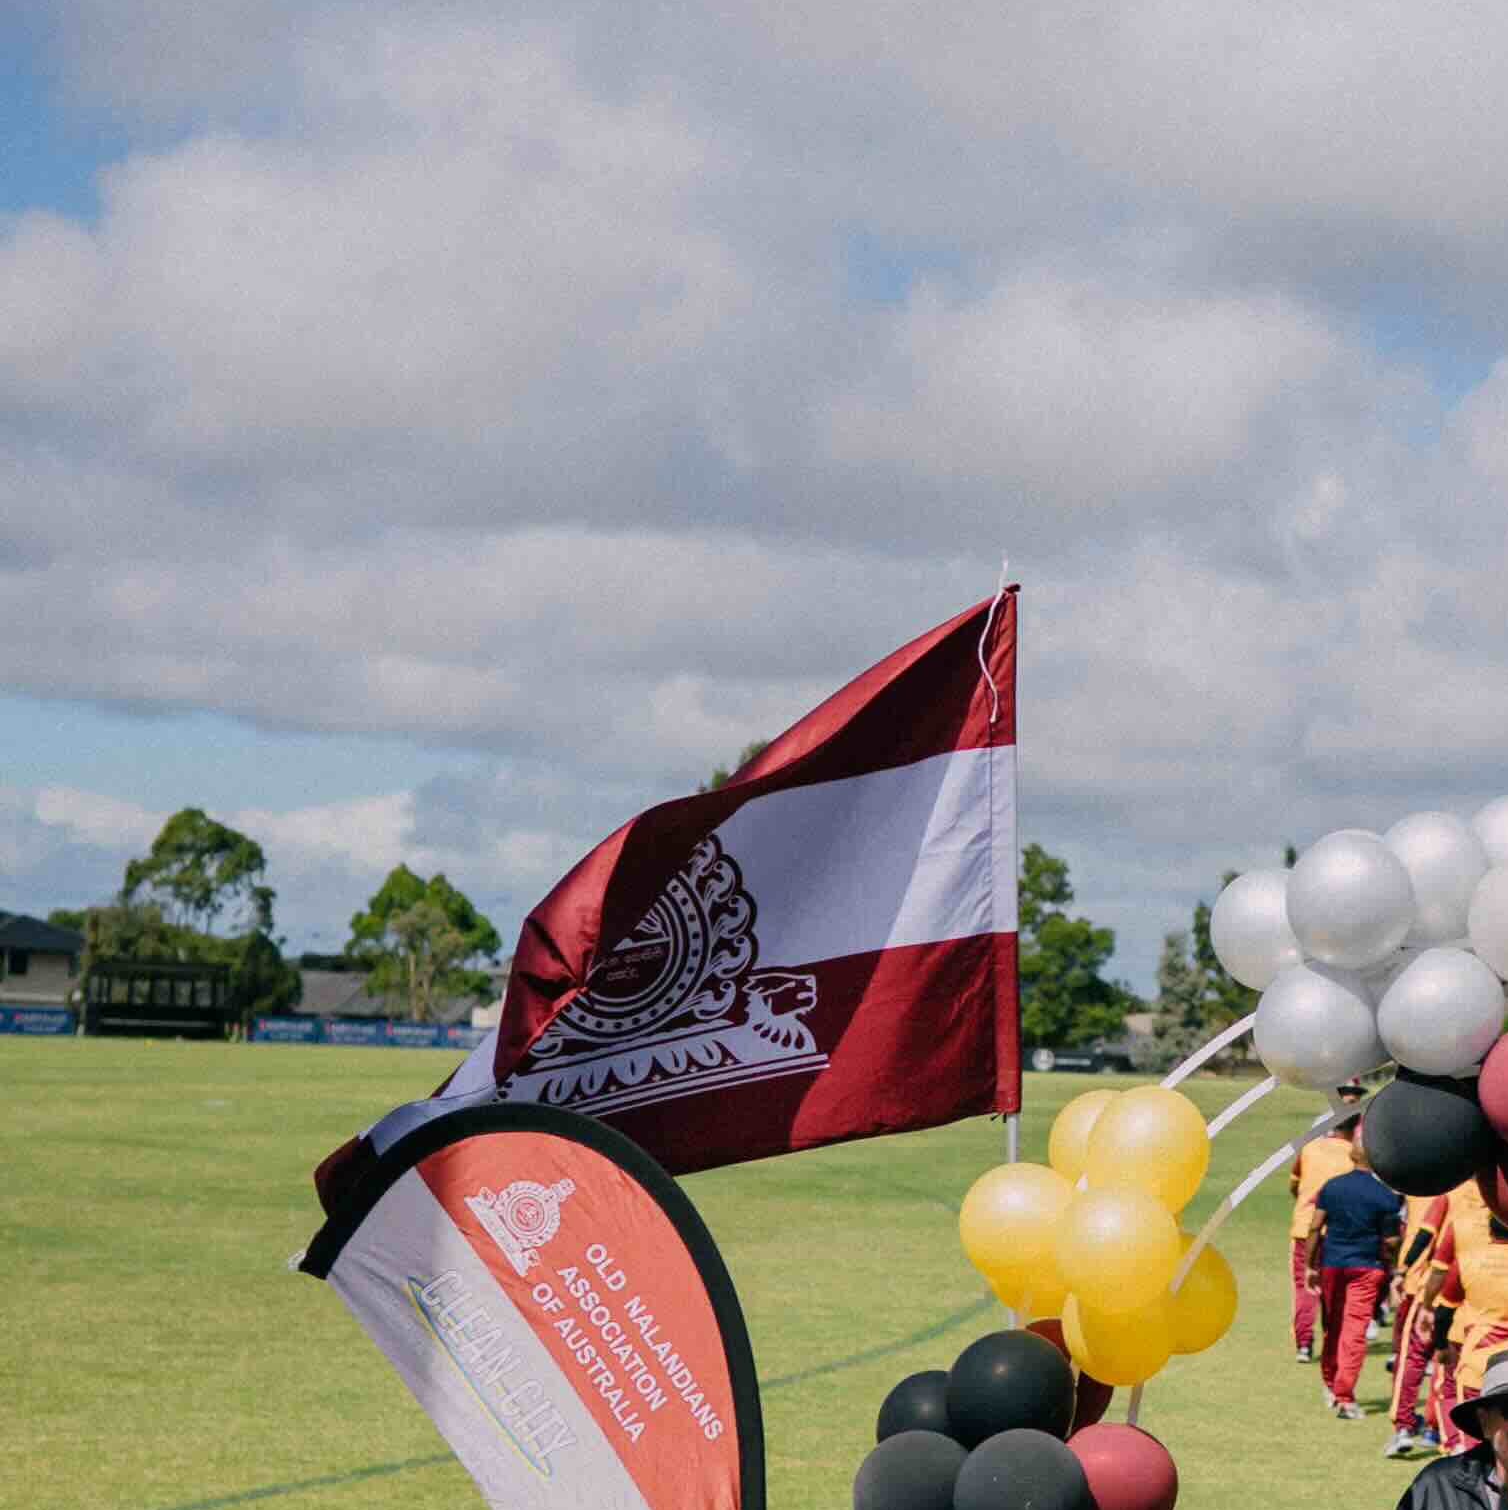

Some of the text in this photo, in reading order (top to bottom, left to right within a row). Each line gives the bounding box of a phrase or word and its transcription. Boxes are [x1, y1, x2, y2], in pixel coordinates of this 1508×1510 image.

[420, 1269, 578, 1459] CLEAN CITY
[531, 1282, 648, 1444] OF AUSTRALIA
[557, 1265, 668, 1412] ASSOCIATION
[584, 1242, 725, 1441] OLD NALANDIANS
